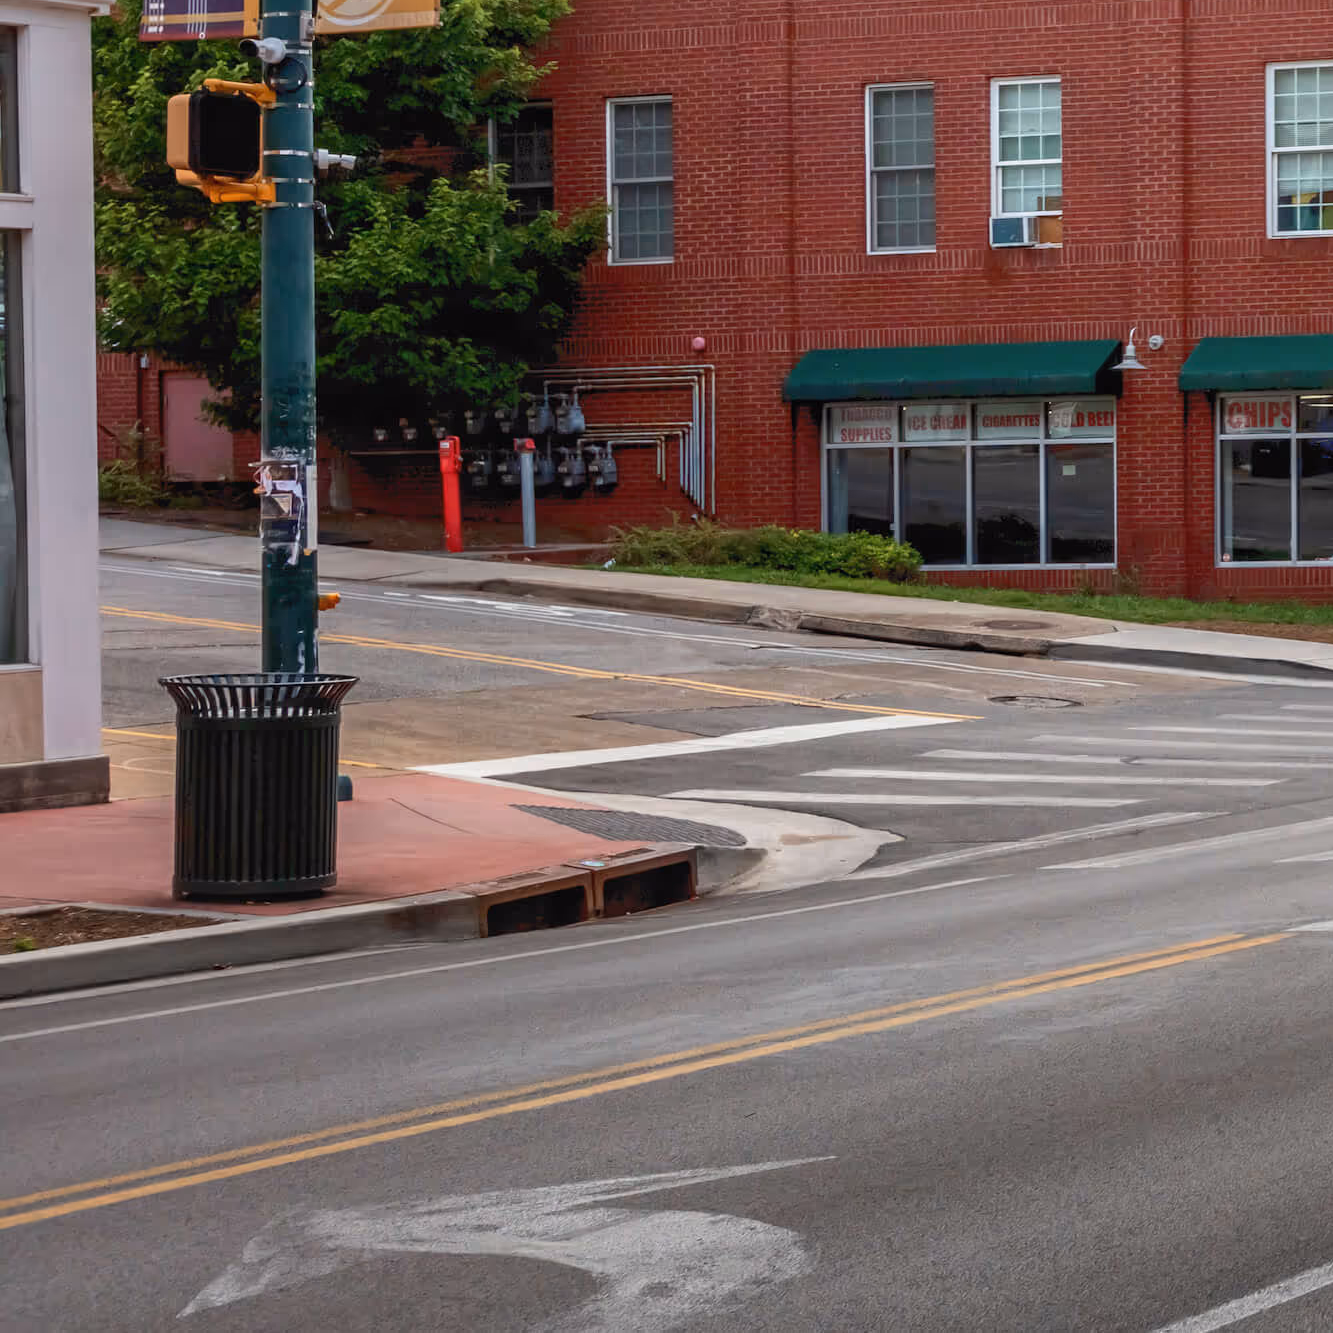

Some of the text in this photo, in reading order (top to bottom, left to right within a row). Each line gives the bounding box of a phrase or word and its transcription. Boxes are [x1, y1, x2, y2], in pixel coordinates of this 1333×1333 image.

[982, 413, 1040, 427] CIGARETTES
[1228, 401, 1291, 429] CHIPS
[840, 426, 892, 442] SUPPLIES
